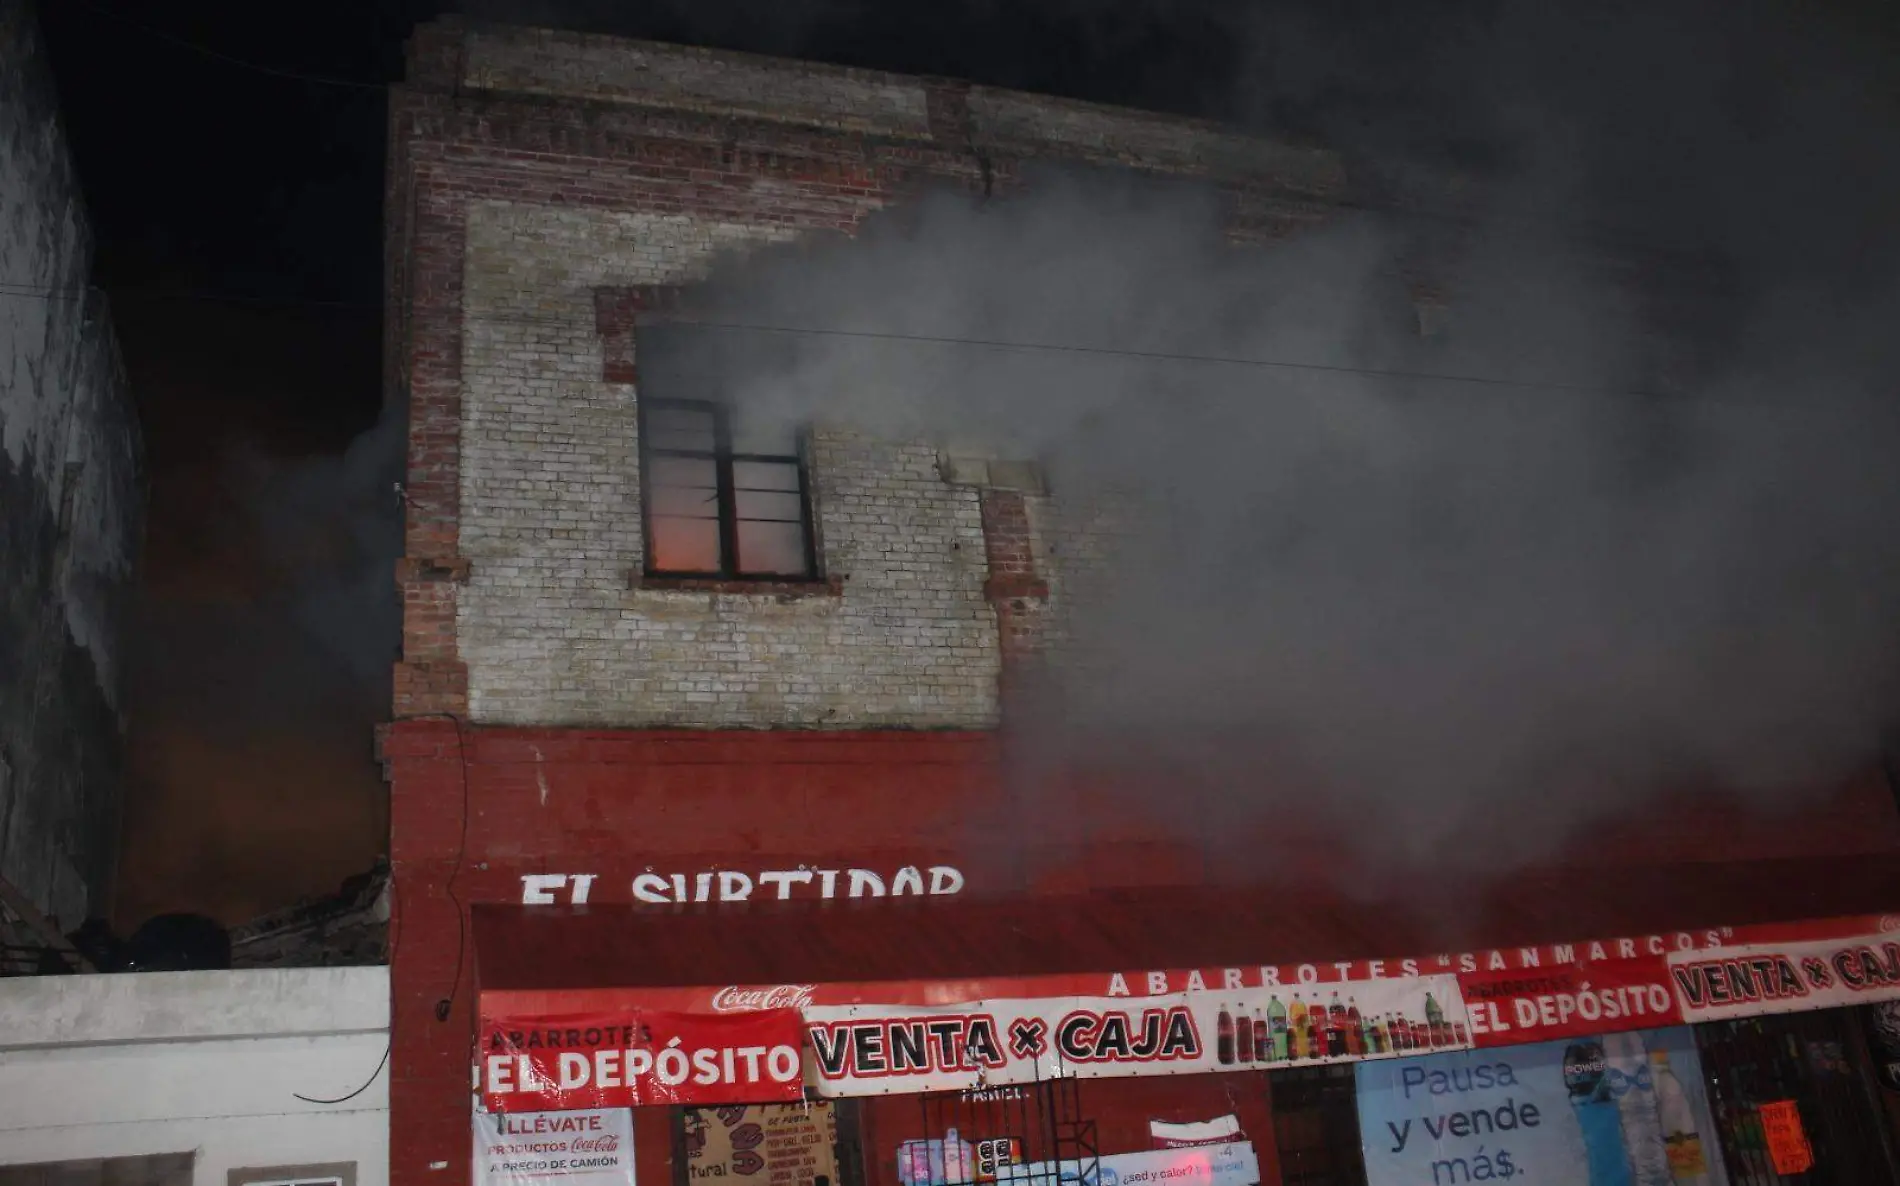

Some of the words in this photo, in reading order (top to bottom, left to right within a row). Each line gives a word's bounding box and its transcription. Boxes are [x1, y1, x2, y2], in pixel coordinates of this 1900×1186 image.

[1108, 960, 1420, 996] ABARROTES
[1672, 957, 1806, 1008] VENTA
[711, 984, 818, 1011] Coca-Cola
[1465, 1001, 1512, 1034] EL
[1514, 982, 1672, 1030] DEPÓSITO
[490, 1025, 654, 1050] ABARROTES
[810, 1018, 1002, 1076] VENTA
[1057, 1008, 1201, 1062] CAJA
[487, 1053, 544, 1094] EL
[559, 1036, 800, 1091] DEPÓSITO
[1401, 1063, 1519, 1098] Pausa
[507, 1114, 602, 1135] LLÉVATE
[1387, 1118, 1412, 1153] y
[1422, 1099, 1541, 1140] vende
[487, 1142, 566, 1156] PRODUCTOS
[571, 1135, 619, 1154] Coca-Cola
[503, 1160, 547, 1171] PRECIO
[550, 1159, 567, 1169] DE
[570, 1156, 618, 1167] CAMIÓN
[690, 1161, 727, 1178] tural
[1123, 1167, 1149, 1185] ¿sed
[1160, 1165, 1194, 1179] calor?
